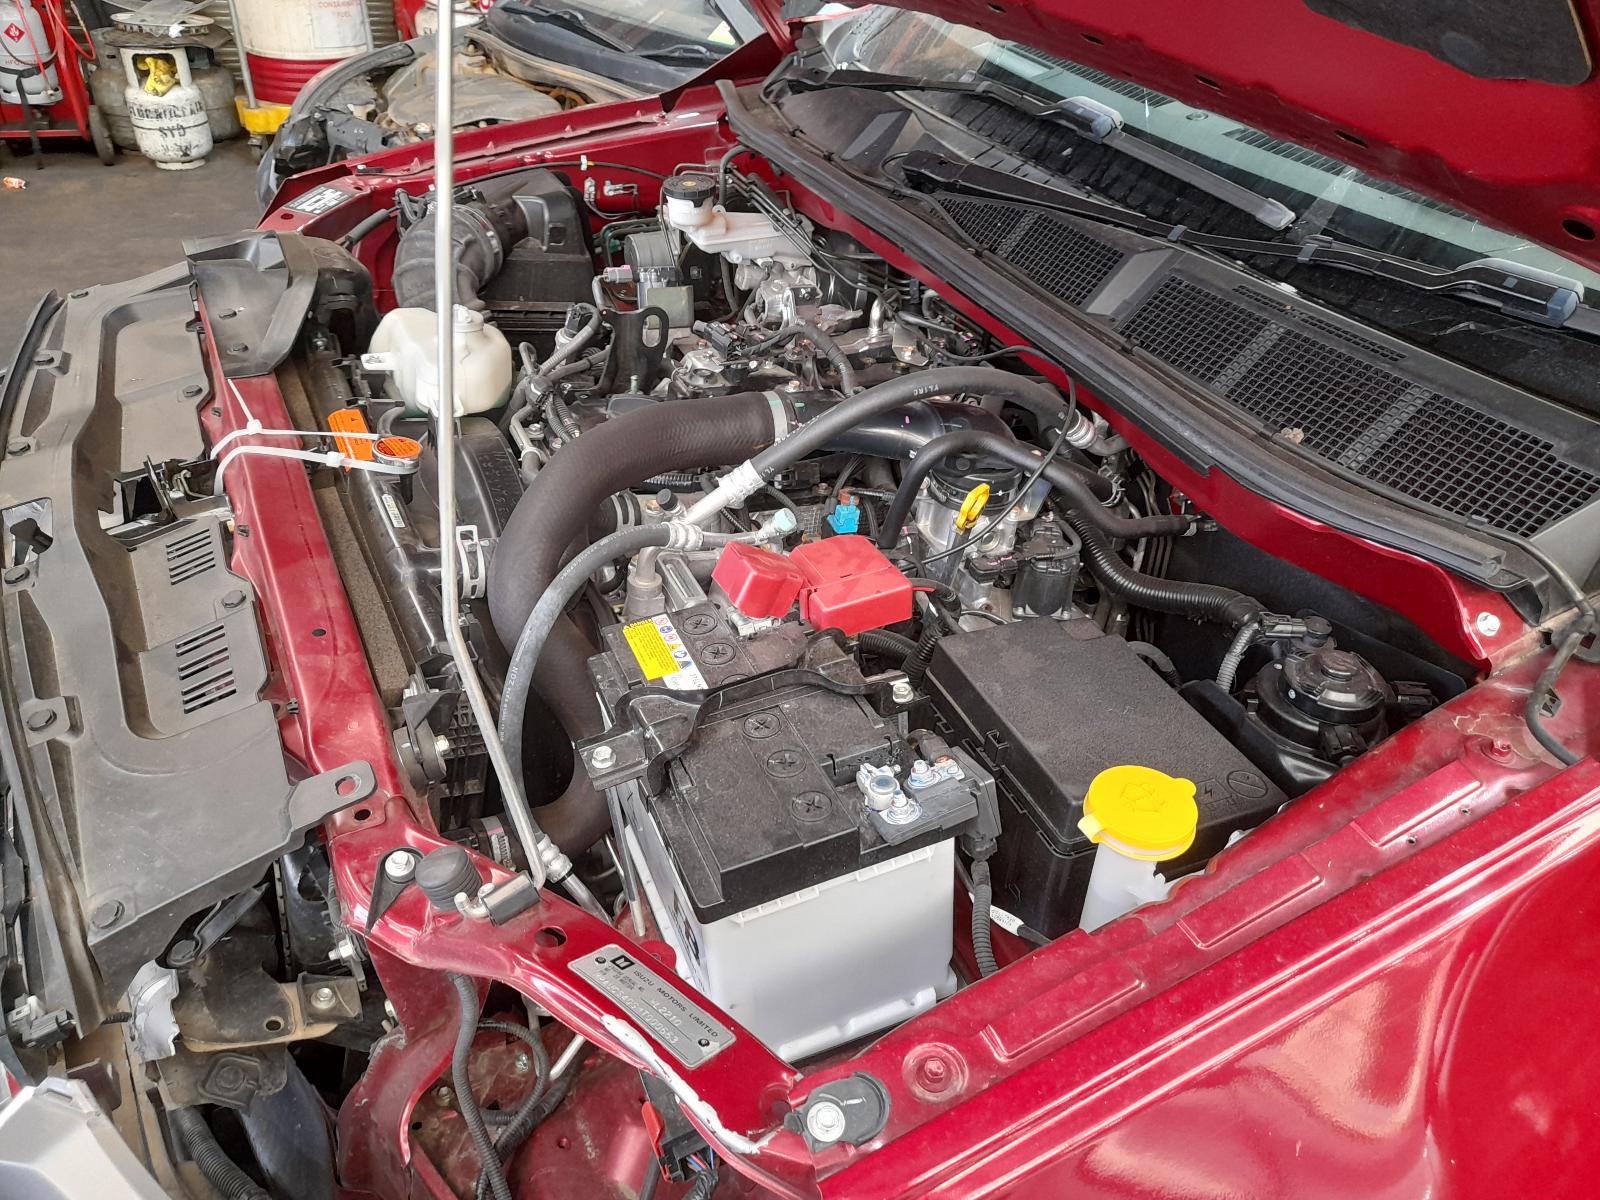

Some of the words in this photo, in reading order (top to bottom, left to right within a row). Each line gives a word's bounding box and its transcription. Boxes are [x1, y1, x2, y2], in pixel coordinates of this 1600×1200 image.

[633, 970, 655, 987] ISUZU
[656, 986, 689, 1013] MOTORS
[688, 1012, 719, 1038] LIMITED
